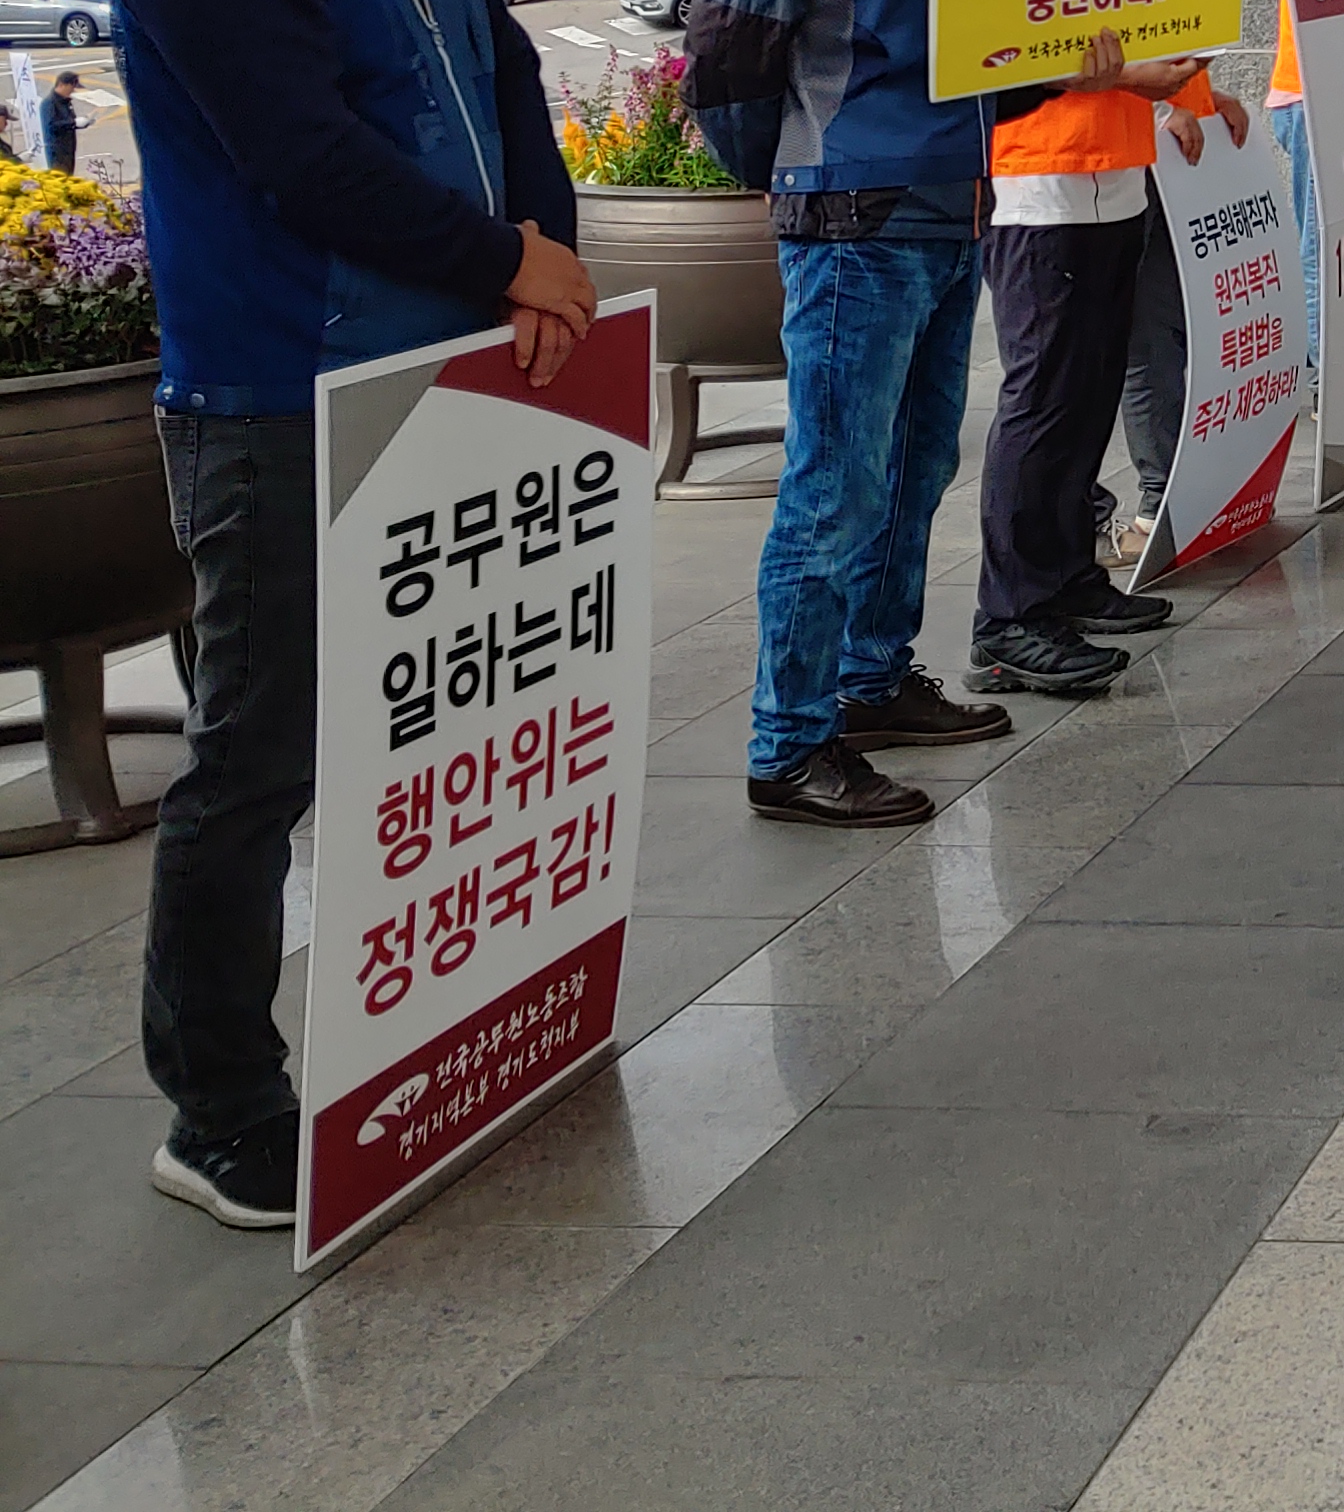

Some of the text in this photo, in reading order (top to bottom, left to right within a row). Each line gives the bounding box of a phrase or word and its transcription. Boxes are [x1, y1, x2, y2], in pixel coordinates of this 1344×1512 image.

[1137, 15, 1203, 38] 경기도청지부
[1188, 189, 1280, 260] 공무원해직자
[1214, 248, 1281, 317] 원직복직
[1192, 365, 1300, 443] 즉각 제정하라!
[1220, 312, 1285, 374] 특별법을
[380, 450, 620, 619] 공무원은
[381, 563, 616, 753] 일하는데
[376, 695, 616, 881] 행안위는
[356, 791, 618, 1018] 정쟁국감!
[400, 1008, 581, 1162] 경기지역본부 경기도청지부
[436, 964, 589, 1090] 전국공무원노동조합
